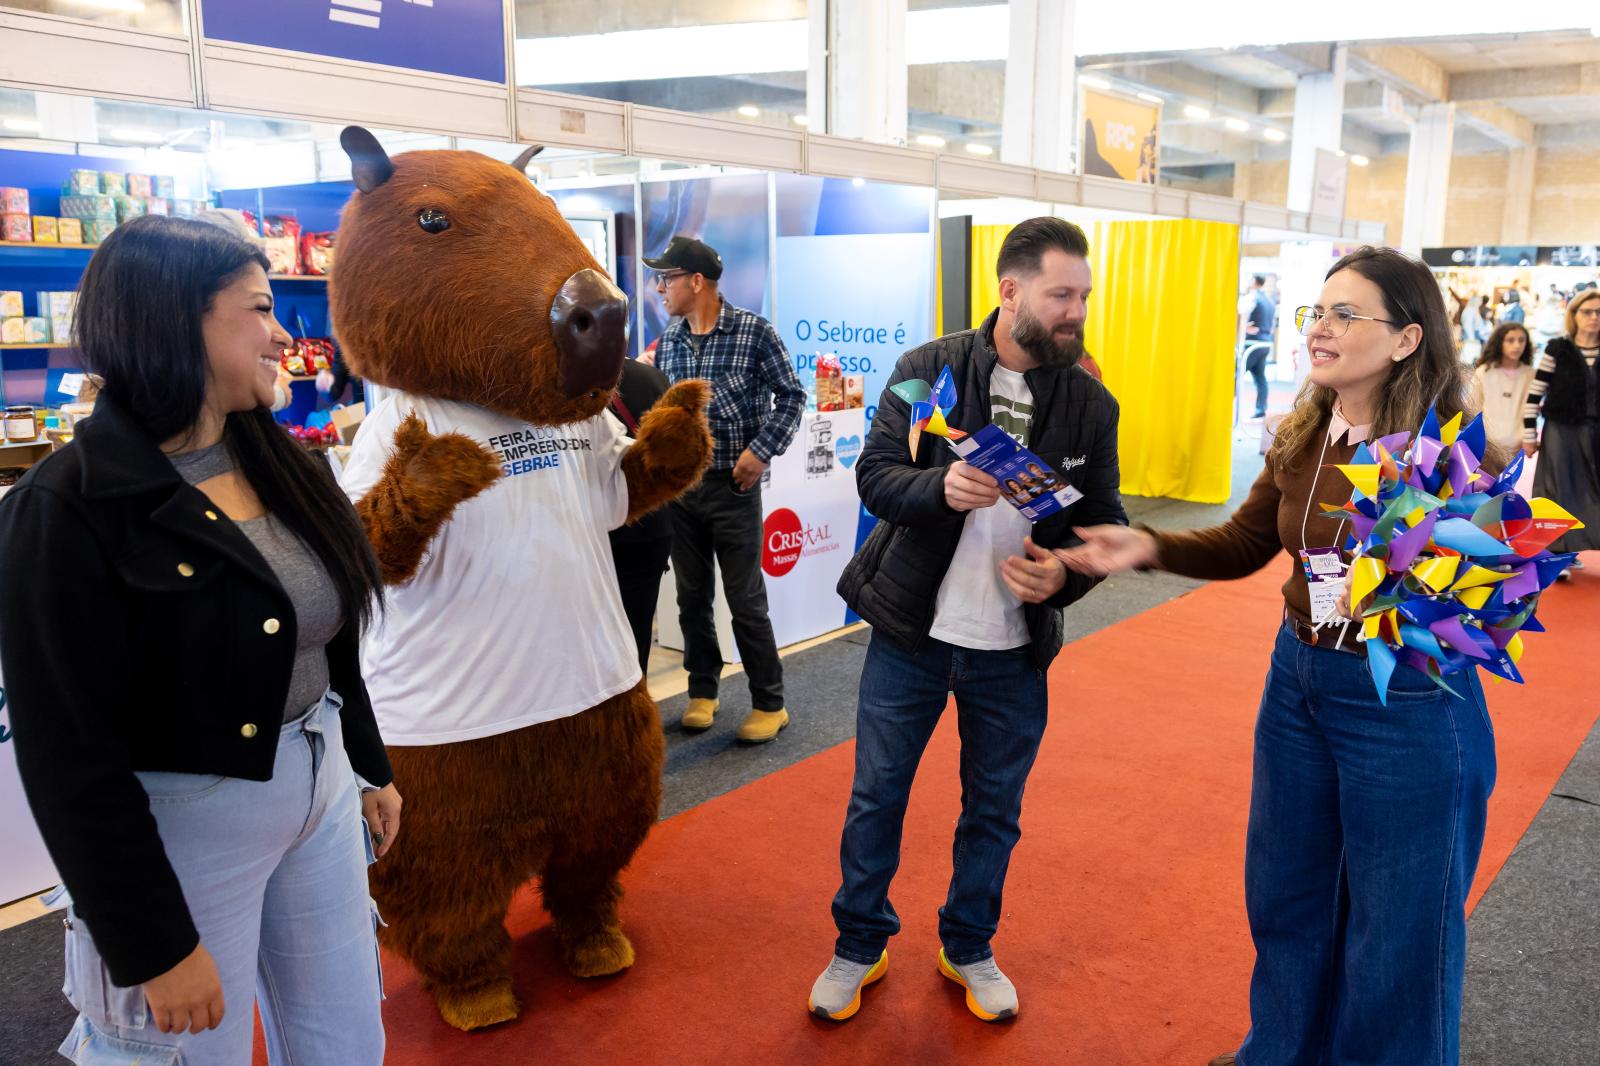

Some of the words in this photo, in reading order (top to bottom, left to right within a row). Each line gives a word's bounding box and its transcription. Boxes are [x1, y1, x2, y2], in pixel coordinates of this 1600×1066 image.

[796, 320, 811, 340] O
[818, 320, 887, 344] Sebrae
[894, 322, 906, 344] é
[796, 353, 819, 374] pr
[834, 350, 877, 373] sso.
[488, 430, 536, 449] FEIRA
[536, 426, 553, 440] DO
[502, 454, 559, 477] SEBRAE
[768, 522, 832, 553] CRISTAL
